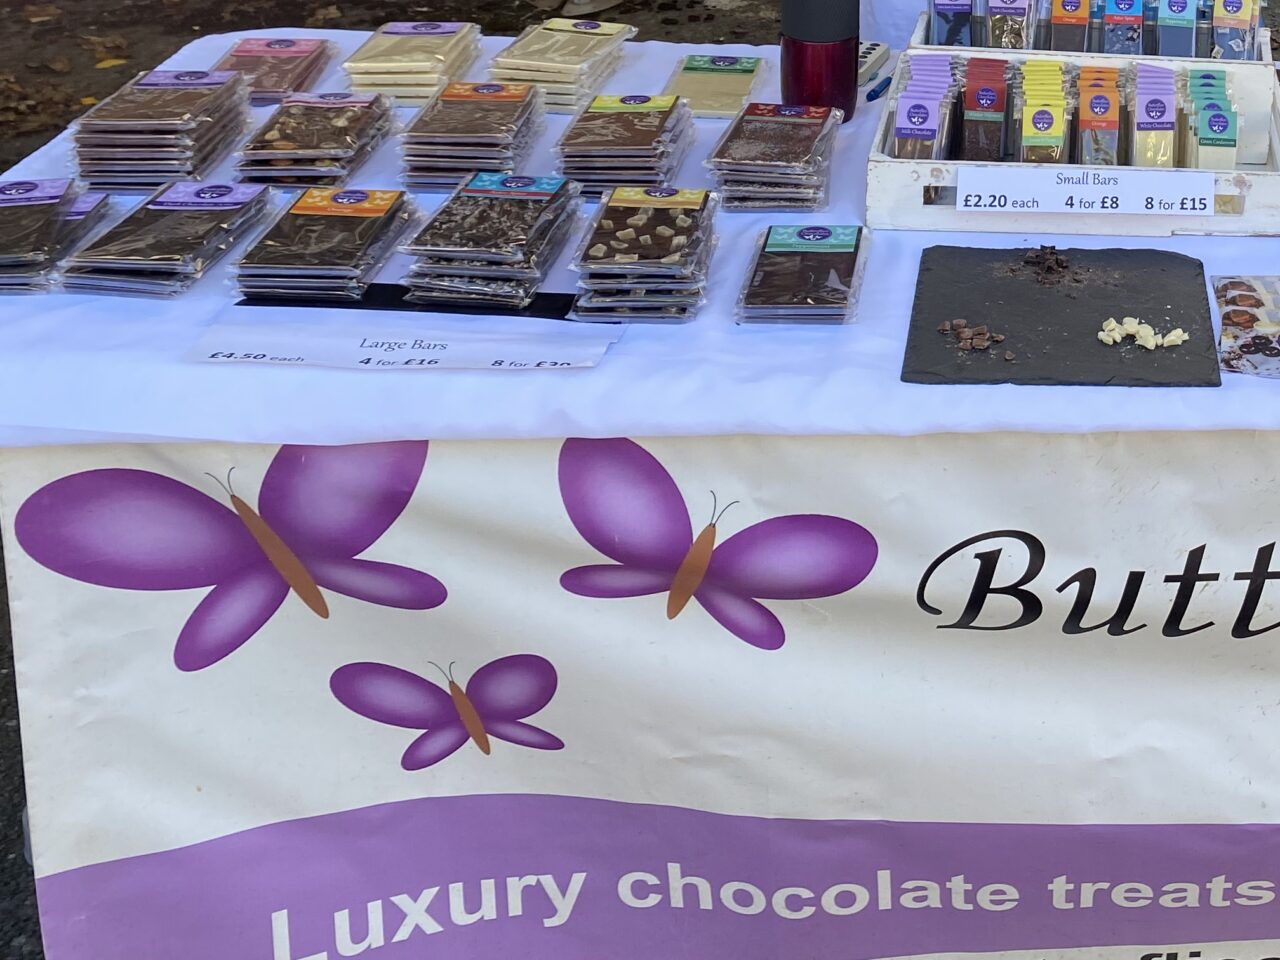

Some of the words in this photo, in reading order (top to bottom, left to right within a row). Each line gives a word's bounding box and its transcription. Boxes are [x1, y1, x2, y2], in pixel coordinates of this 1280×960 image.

[1056, 172, 1089, 185] Small
[1092, 173, 1119, 186] Bars
[963, 194, 1008, 208] £2.20
[1012, 197, 1039, 208] each
[1065, 195, 1074, 208] 4
[1079, 196, 1096, 209] for
[1100, 196, 1119, 209] £8
[1145, 197, 1154, 210] 8
[1159, 198, 1175, 211] for
[1179, 197, 1207, 211] £15
[360, 338, 407, 352] Large
[411, 340, 448, 351] Bars
[208, 352, 267, 360] £4.50
[358, 357, 373, 365] 4
[270, 871, 588, 960] Luxury
[617, 862, 1020, 920] chocolate
